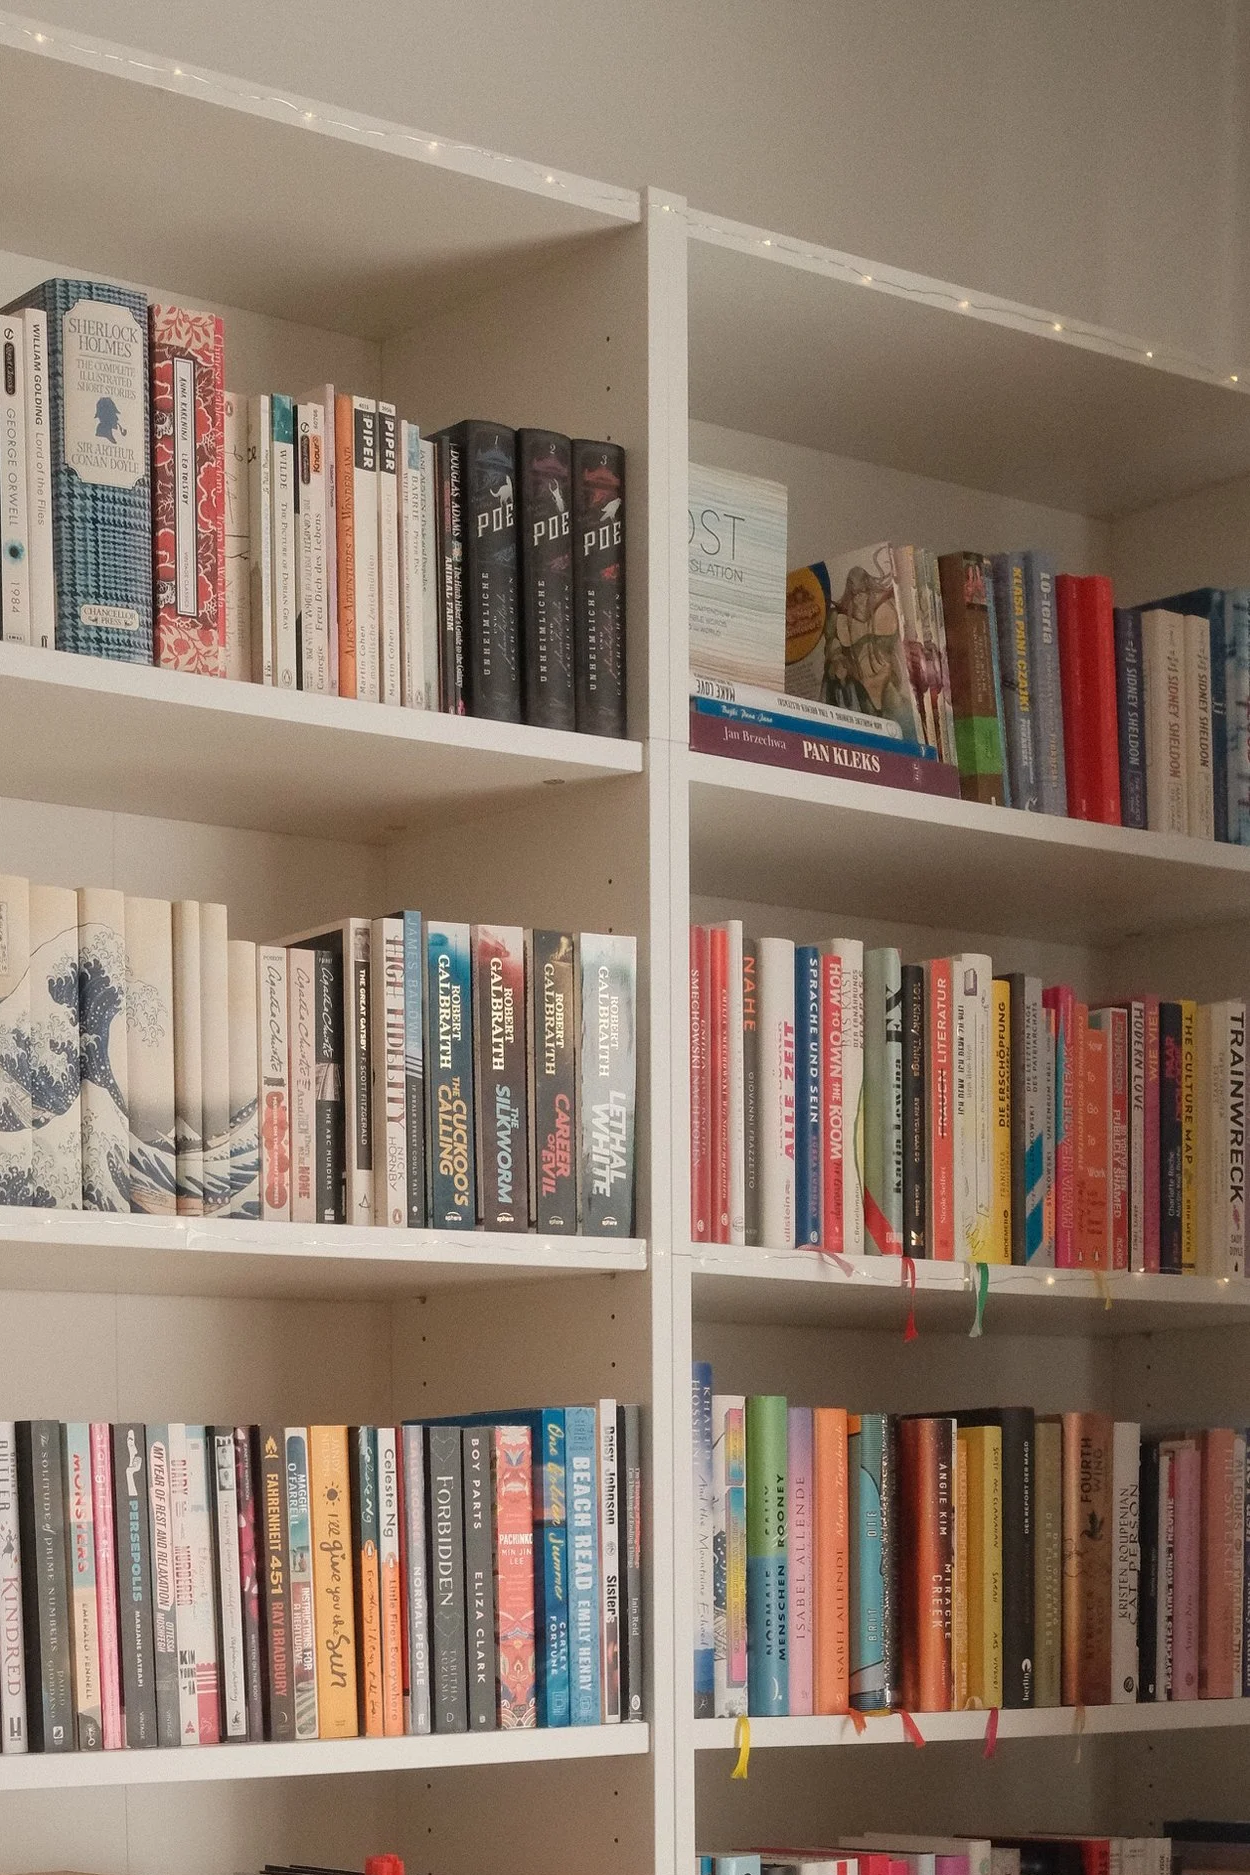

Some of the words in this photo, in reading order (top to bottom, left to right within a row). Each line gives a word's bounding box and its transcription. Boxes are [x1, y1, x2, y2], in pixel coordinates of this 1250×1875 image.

[68, 318, 138, 344] SHERLOCK
[78, 336, 132, 359] HOLMES
[5, 407, 15, 464] GEORGE
[362, 417, 374, 468] PIPER
[384, 418, 394, 470] PIPER
[7, 469, 18, 526] ORWELL
[477, 503, 515, 537] POE
[533, 512, 570, 546] POE
[584, 521, 621, 556] POE
[10, 580, 20, 614] 1984
[84, 606, 136, 619] CHANCELLOR
[723, 725, 738, 743] Jan
[741, 729, 787, 751] Brzechwa
[802, 741, 831, 764] PAN
[832, 744, 881, 773] KLEKS
[439, 954, 451, 1069] GALBRAITH
[451, 984, 461, 1041] ROBERT
[744, 956, 755, 1032] NAHE
[809, 959, 819, 1036] SPRACHE
[359, 1018, 367, 1051] GATSBY
[810, 1041, 818, 1079] UND
[810, 1086, 818, 1124] SEIN
[1184, 1048, 1193, 1123] CULTURE
[1230, 1012, 1245, 1204] TRAINWRECK
[438, 1085, 453, 1175] CALLING
[452, 1099, 468, 1206] CUCKOO'S
[495, 1084, 512, 1204] SILKWORM
[555, 1094, 570, 1178] CAREER
[591, 1103, 611, 1198] WHITE
[607, 1090, 626, 1181] LETHAL
[1185, 1129, 1193, 1164] MAP
[471, 1439, 480, 1474] BOY
[1081, 1438, 1091, 1502] FOURTH
[266, 1473, 281, 1551] FAHRENHEIT
[472, 1480, 481, 1530] PARTS
[572, 1457, 590, 1527] BEACH
[777, 1474, 785, 1548] ROONEY
[129, 1501, 142, 1602] PERSEPOLIS
[270, 1556, 283, 1595] 451
[574, 1531, 593, 1590] READ
[272, 1602, 283, 1625] RAY
[475, 1572, 483, 1620] ELIZA
[578, 1601, 591, 1638] EMILY
[778, 1565, 786, 1660] MENSCHEN
[2, 1576, 22, 1697] KINDRED
[273, 1628, 288, 1698] BRADBURY
[476, 1627, 486, 1683] CLARK
[578, 1642, 592, 1692] HENRY
